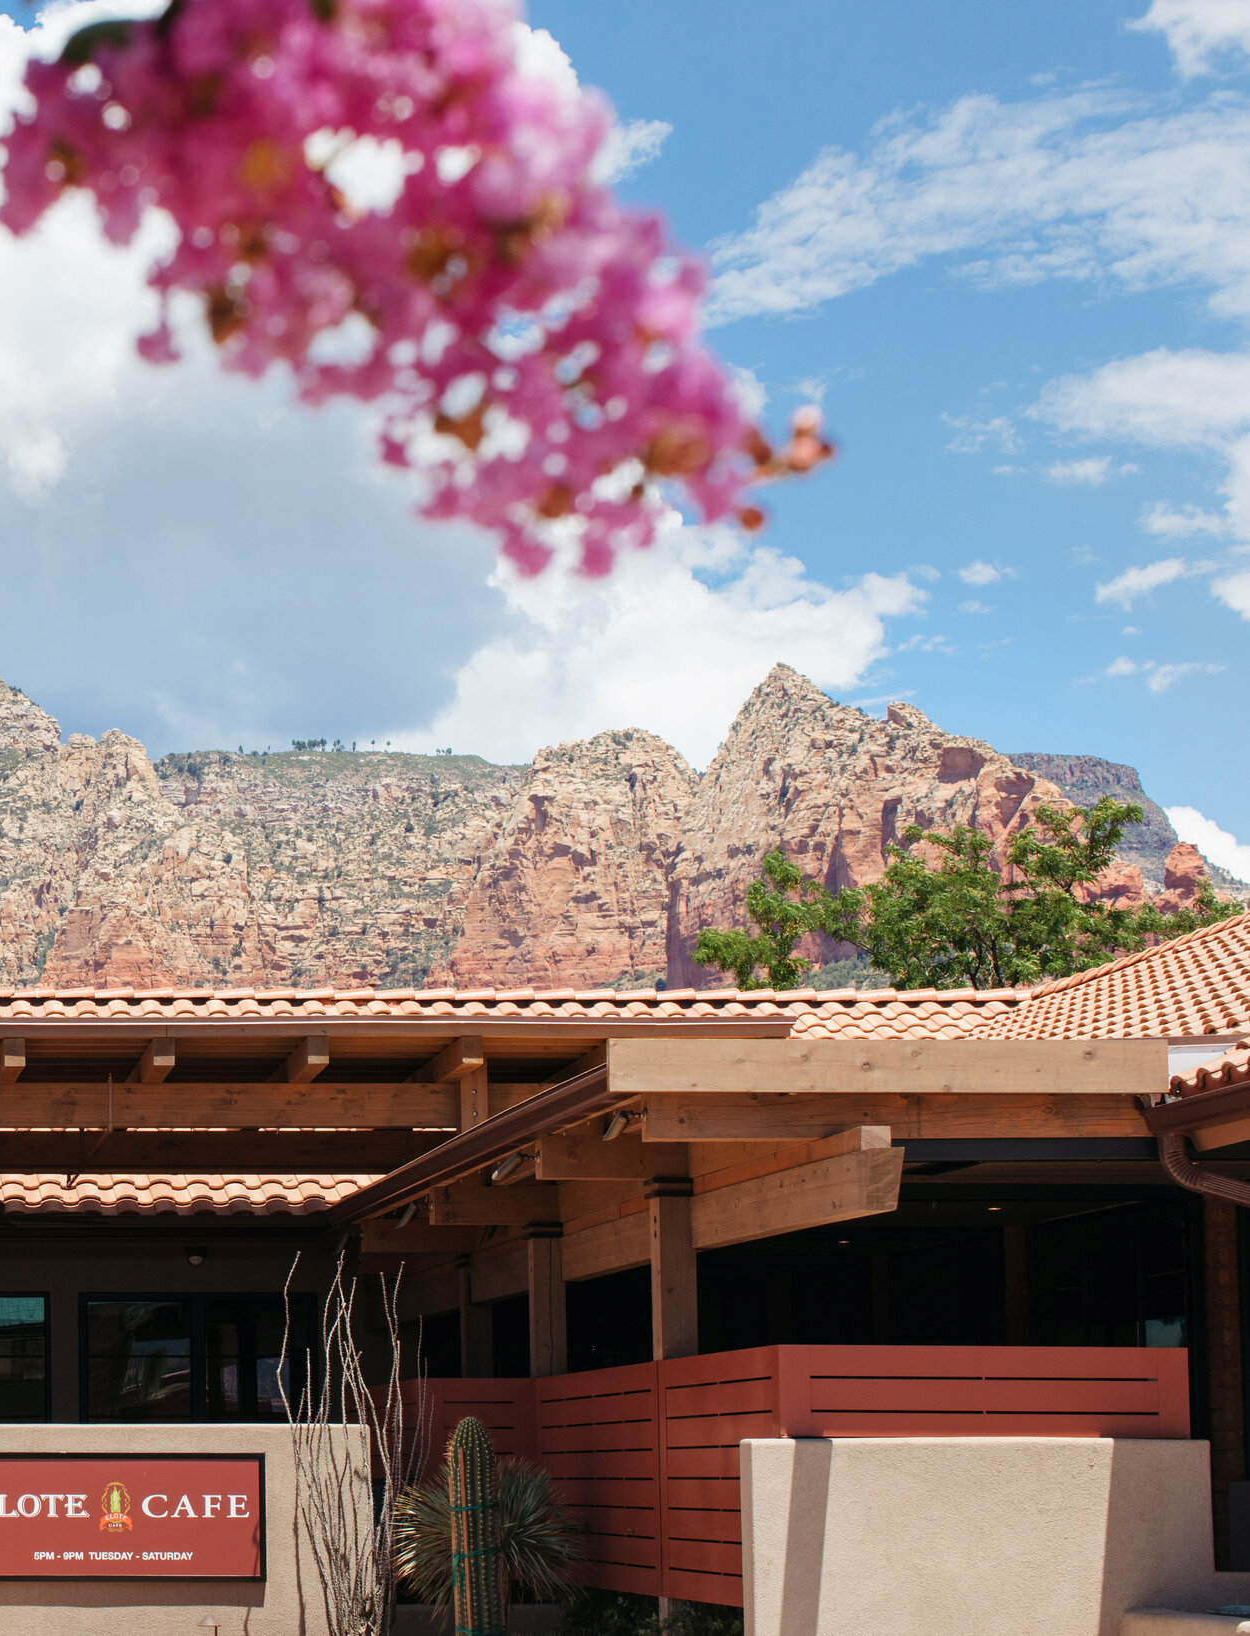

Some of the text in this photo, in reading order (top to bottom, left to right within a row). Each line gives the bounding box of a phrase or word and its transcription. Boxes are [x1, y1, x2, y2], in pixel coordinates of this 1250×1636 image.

[141, 1494, 250, 1518] CAFE
[104, 1512, 129, 1521] ELOTE
[33, 1552, 55, 1561] 5PM
[63, 1552, 84, 1561] 9PM
[88, 1552, 133, 1561] TUESDAY
[142, 1552, 193, 1561] SATURDAY
